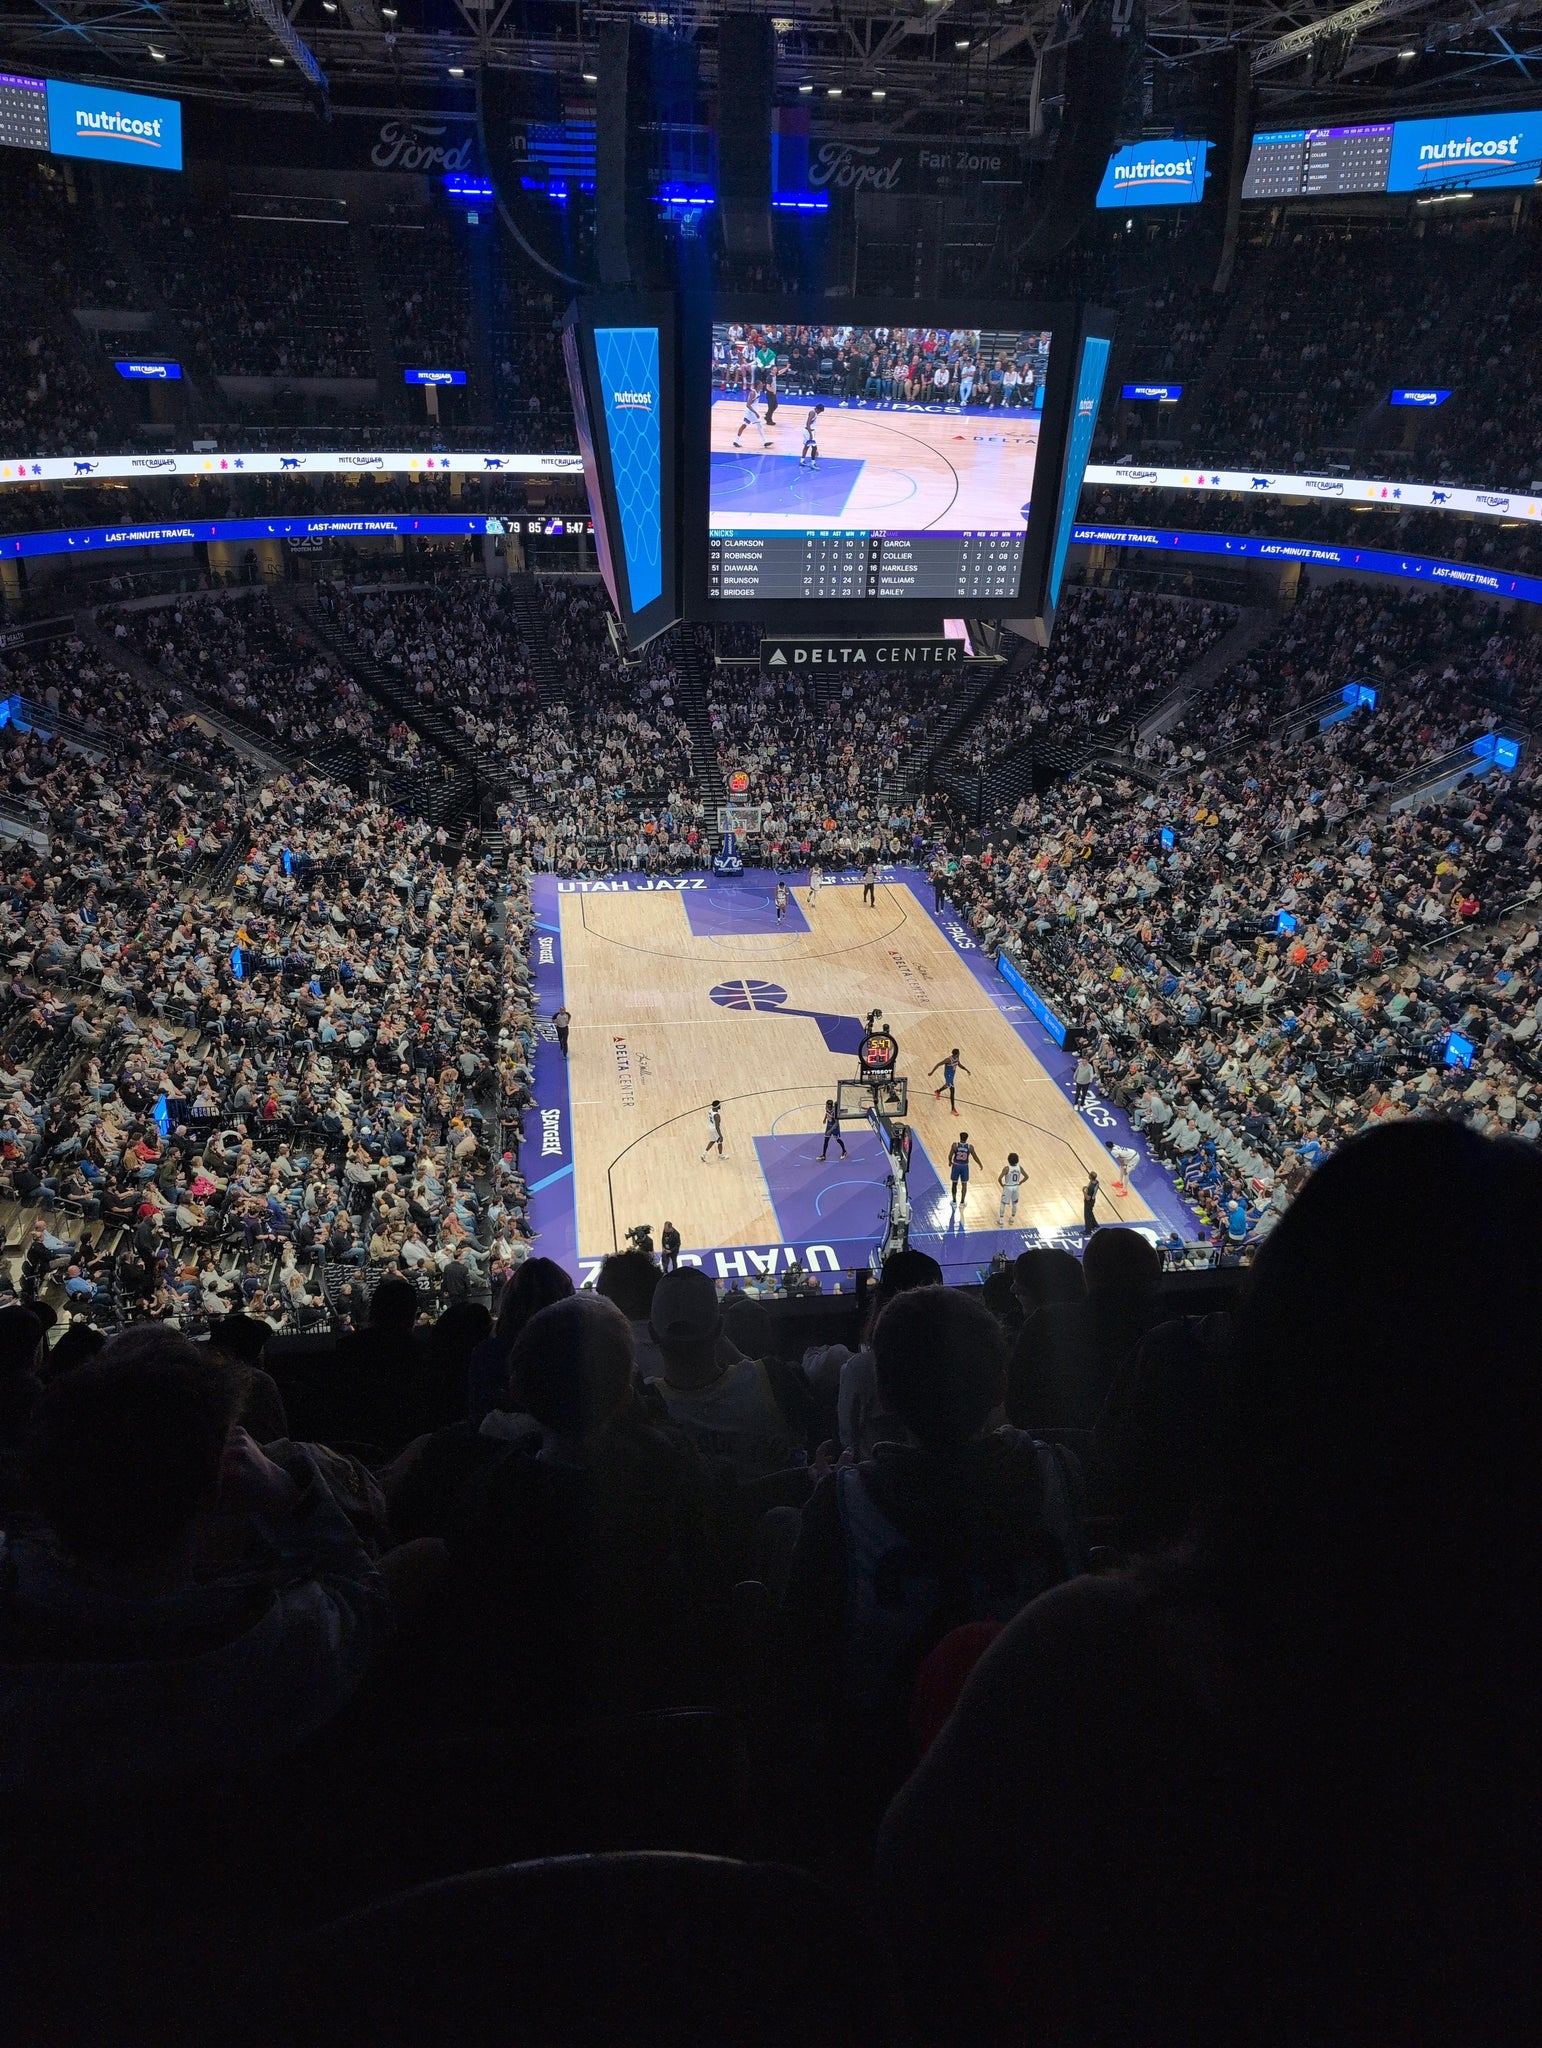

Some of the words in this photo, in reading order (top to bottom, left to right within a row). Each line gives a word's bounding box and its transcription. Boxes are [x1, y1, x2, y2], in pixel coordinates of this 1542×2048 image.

[76, 110, 161, 137] nutricost
[371, 121, 472, 171] Ford
[1420, 136, 1518, 160] nutricost
[808, 142, 903, 190] Ford
[956, 151, 1002, 170] Zone
[1114, 159, 1193, 180] nutricost
[614, 390, 652, 404] nutricost
[892, 403, 961, 414] PACS
[364, 522, 398, 530] TRAVEL,
[508, 522, 520, 532] 79
[528, 522, 541, 532] 85
[566, 522, 584, 533] 5:47
[106, 530, 160, 542] LAST-MINUTE
[162, 528, 194, 538] TRAVEL,
[1075, 531, 1126, 541] LAST-MINUTE
[1128, 534, 1159, 544] TRAVEL,
[1261, 545, 1310, 557] LAST-MINUTE
[1312, 550, 1340, 562] TRAVEL,
[1432, 566, 1475, 582] LAST-MINUTE
[1476, 574, 1500, 588] TRAVEL,
[794, 649, 866, 662] DELTA
[876, 648, 956, 662] CENTER
[558, 881, 630, 892] UTAH
[636, 879, 707, 890] JAZZ
[946, 926, 976, 949] PACS
[893, 956, 912, 977] DELTA
[906, 979, 930, 1002] CENTER
[872, 1040, 890, 1048] 5:47
[616, 1044, 630, 1072] DELTA
[868, 1048, 888, 1064] 24
[618, 1074, 634, 1107] CENTER
[541, 1109, 562, 1156] SEATGEEK
[714, 1245, 840, 1278] UTAH
[418, 1281, 430, 1290] 22
